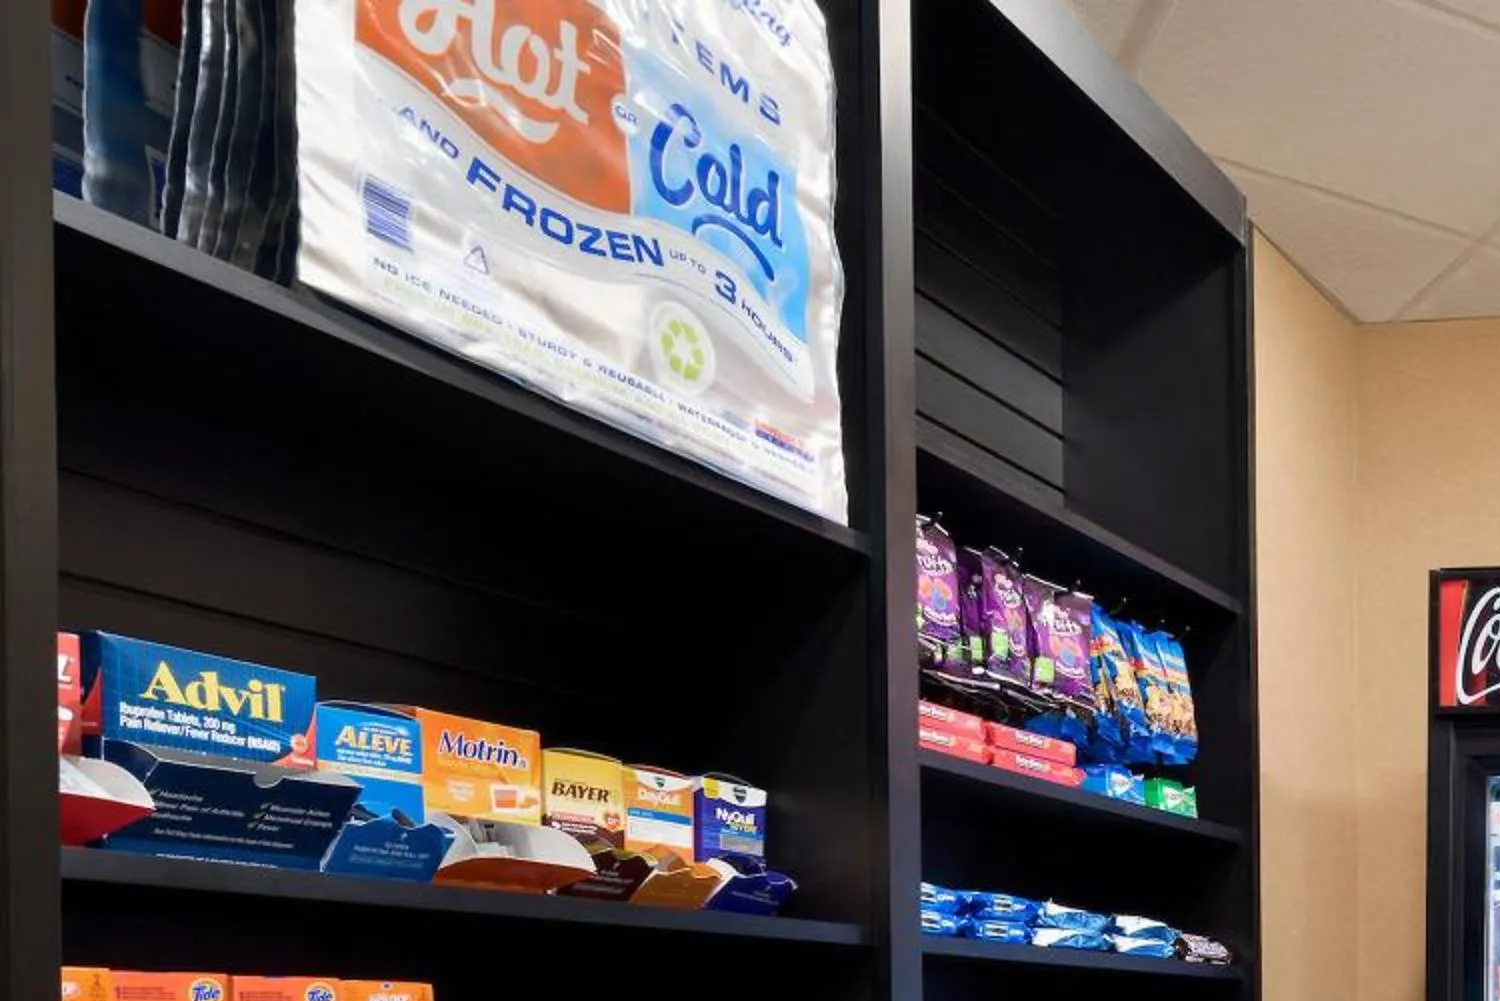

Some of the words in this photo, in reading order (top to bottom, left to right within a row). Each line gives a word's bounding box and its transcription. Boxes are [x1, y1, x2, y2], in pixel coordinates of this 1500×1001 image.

[649, 102, 783, 248] Cold
[399, 105, 460, 160] AND
[465, 156, 665, 267] FROZEN
[714, 269, 737, 305] 3
[741, 299, 793, 362] HOURS
[139, 660, 285, 723] Advil
[335, 725, 414, 757] ALEVE
[437, 729, 519, 768] Motrin
[551, 780, 611, 803] BAYER
